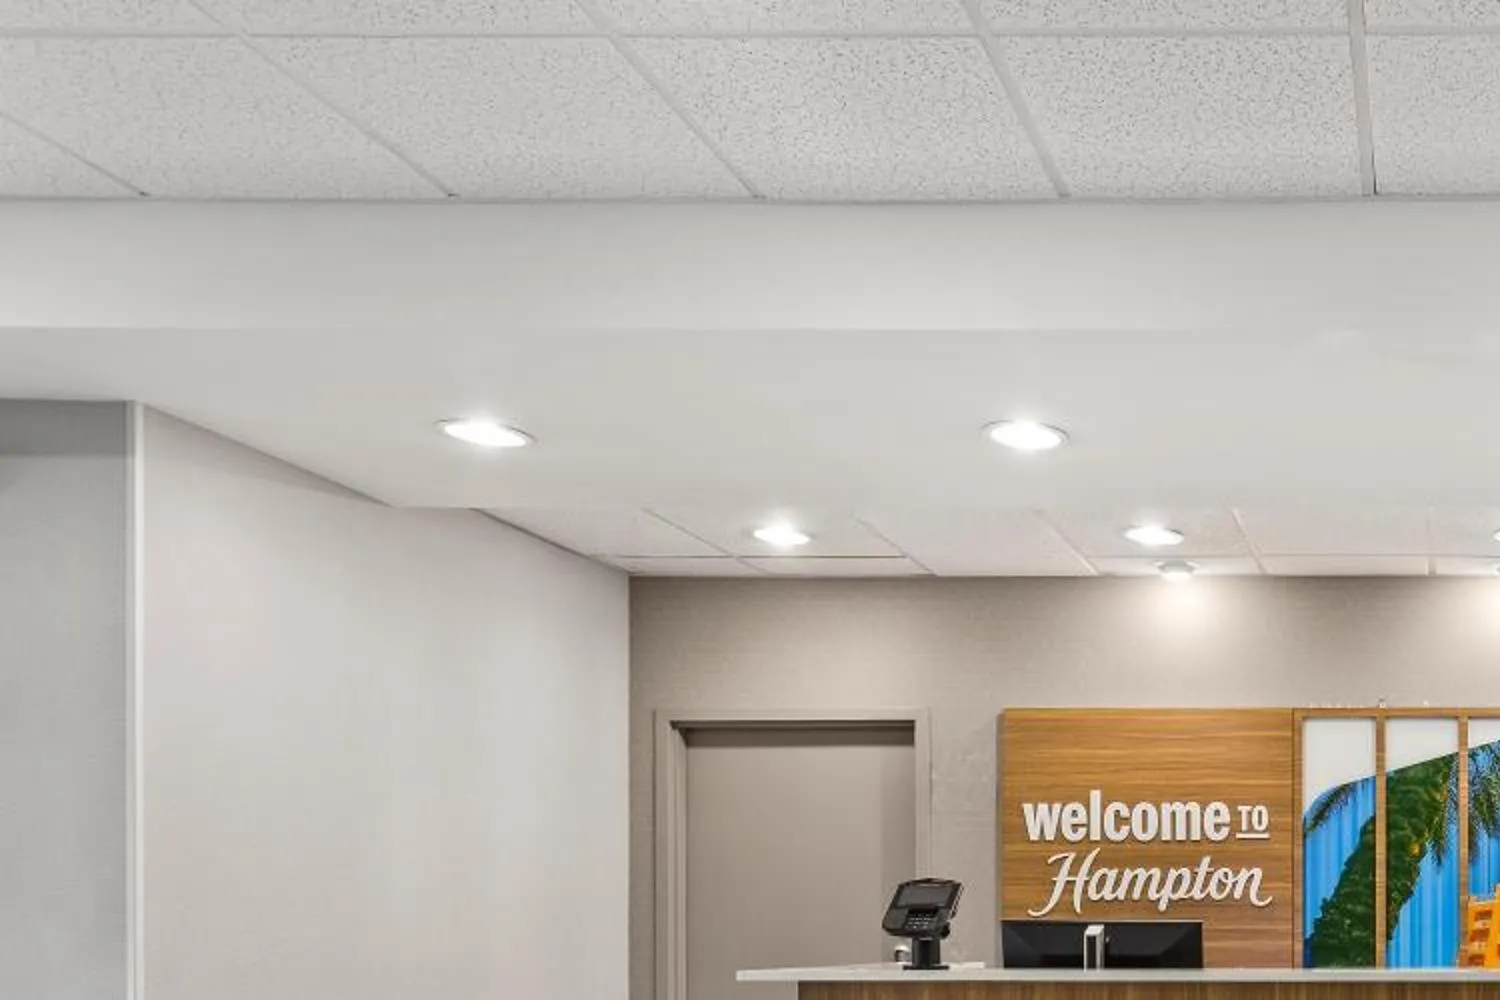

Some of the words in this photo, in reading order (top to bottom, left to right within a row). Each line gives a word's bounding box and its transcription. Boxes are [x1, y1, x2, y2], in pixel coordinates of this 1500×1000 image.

[1022, 789, 1231, 842] welcome
[1236, 804, 1270, 839] TO
[1027, 847, 1273, 917] Hampton
